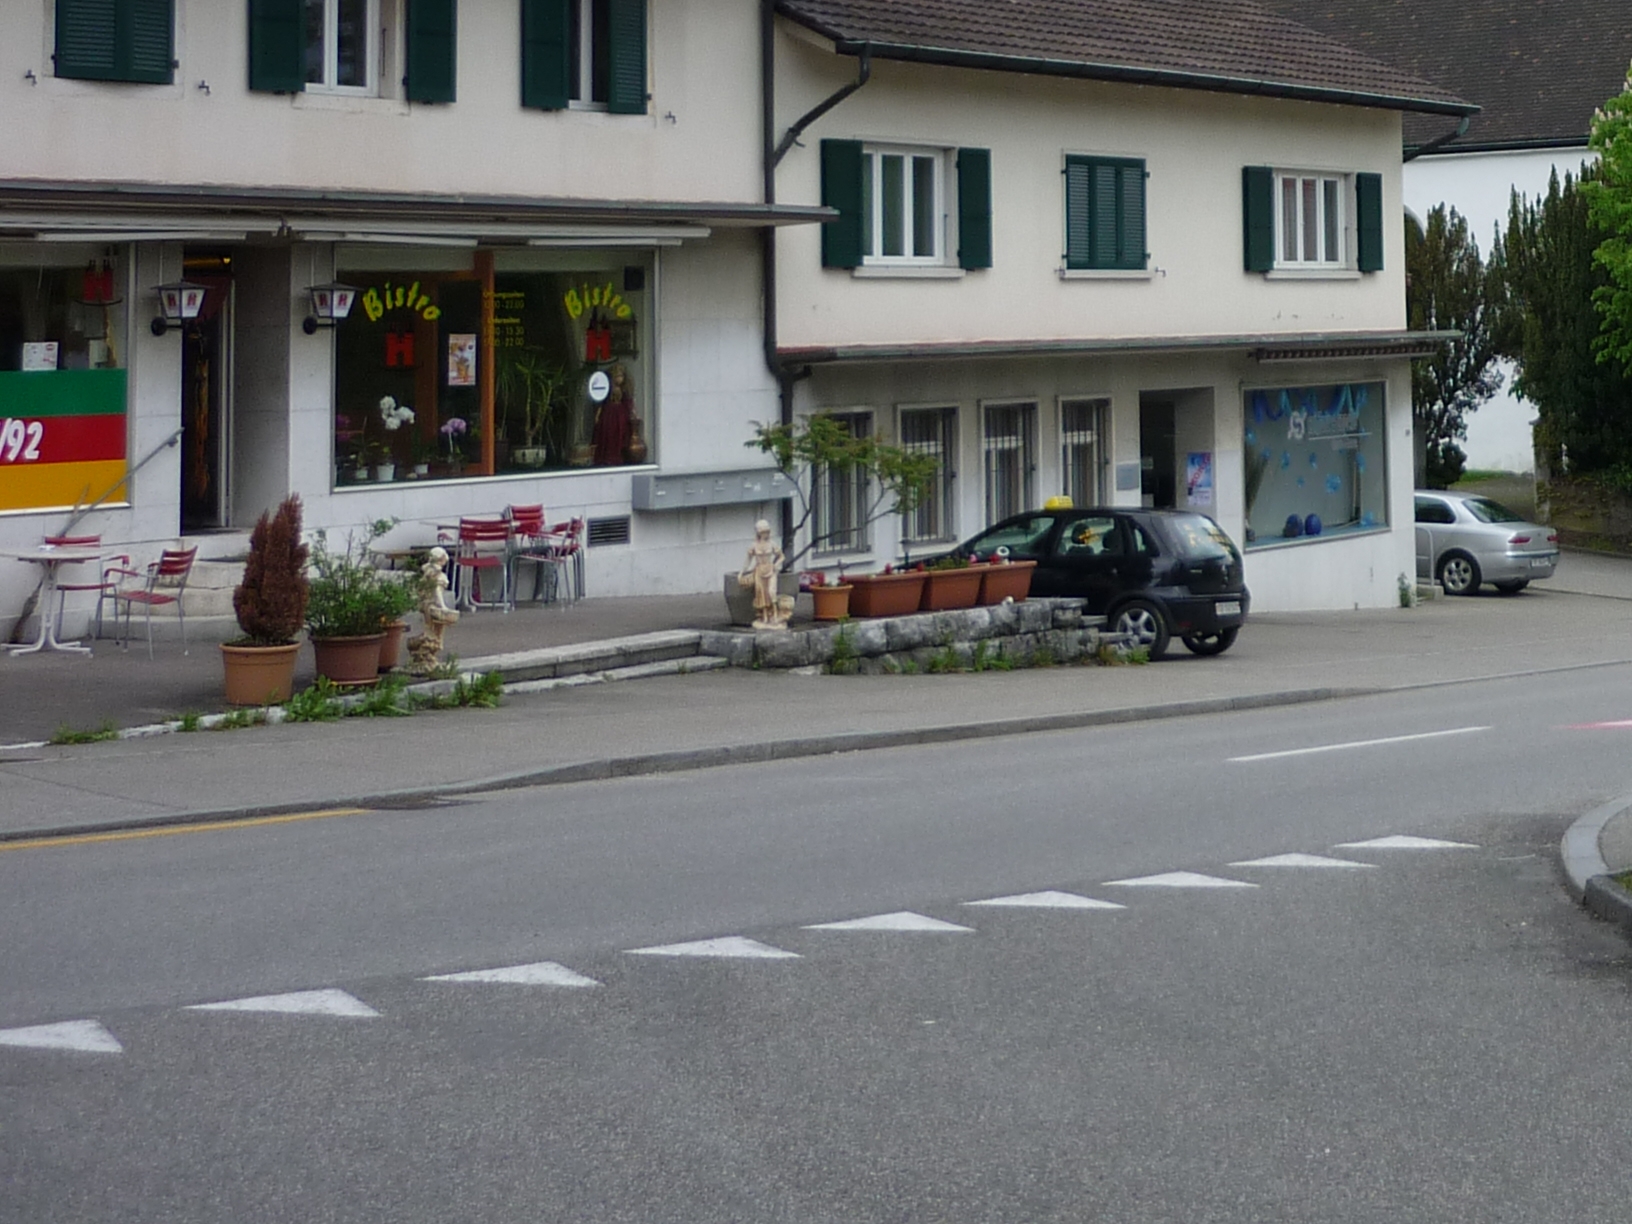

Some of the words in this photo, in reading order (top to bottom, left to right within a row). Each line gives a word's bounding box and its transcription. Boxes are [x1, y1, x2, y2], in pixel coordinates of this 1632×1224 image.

[363, 281, 441, 322] Bistro
[564, 282, 632, 320] Bistro
[0, 417, 43, 462] /92
